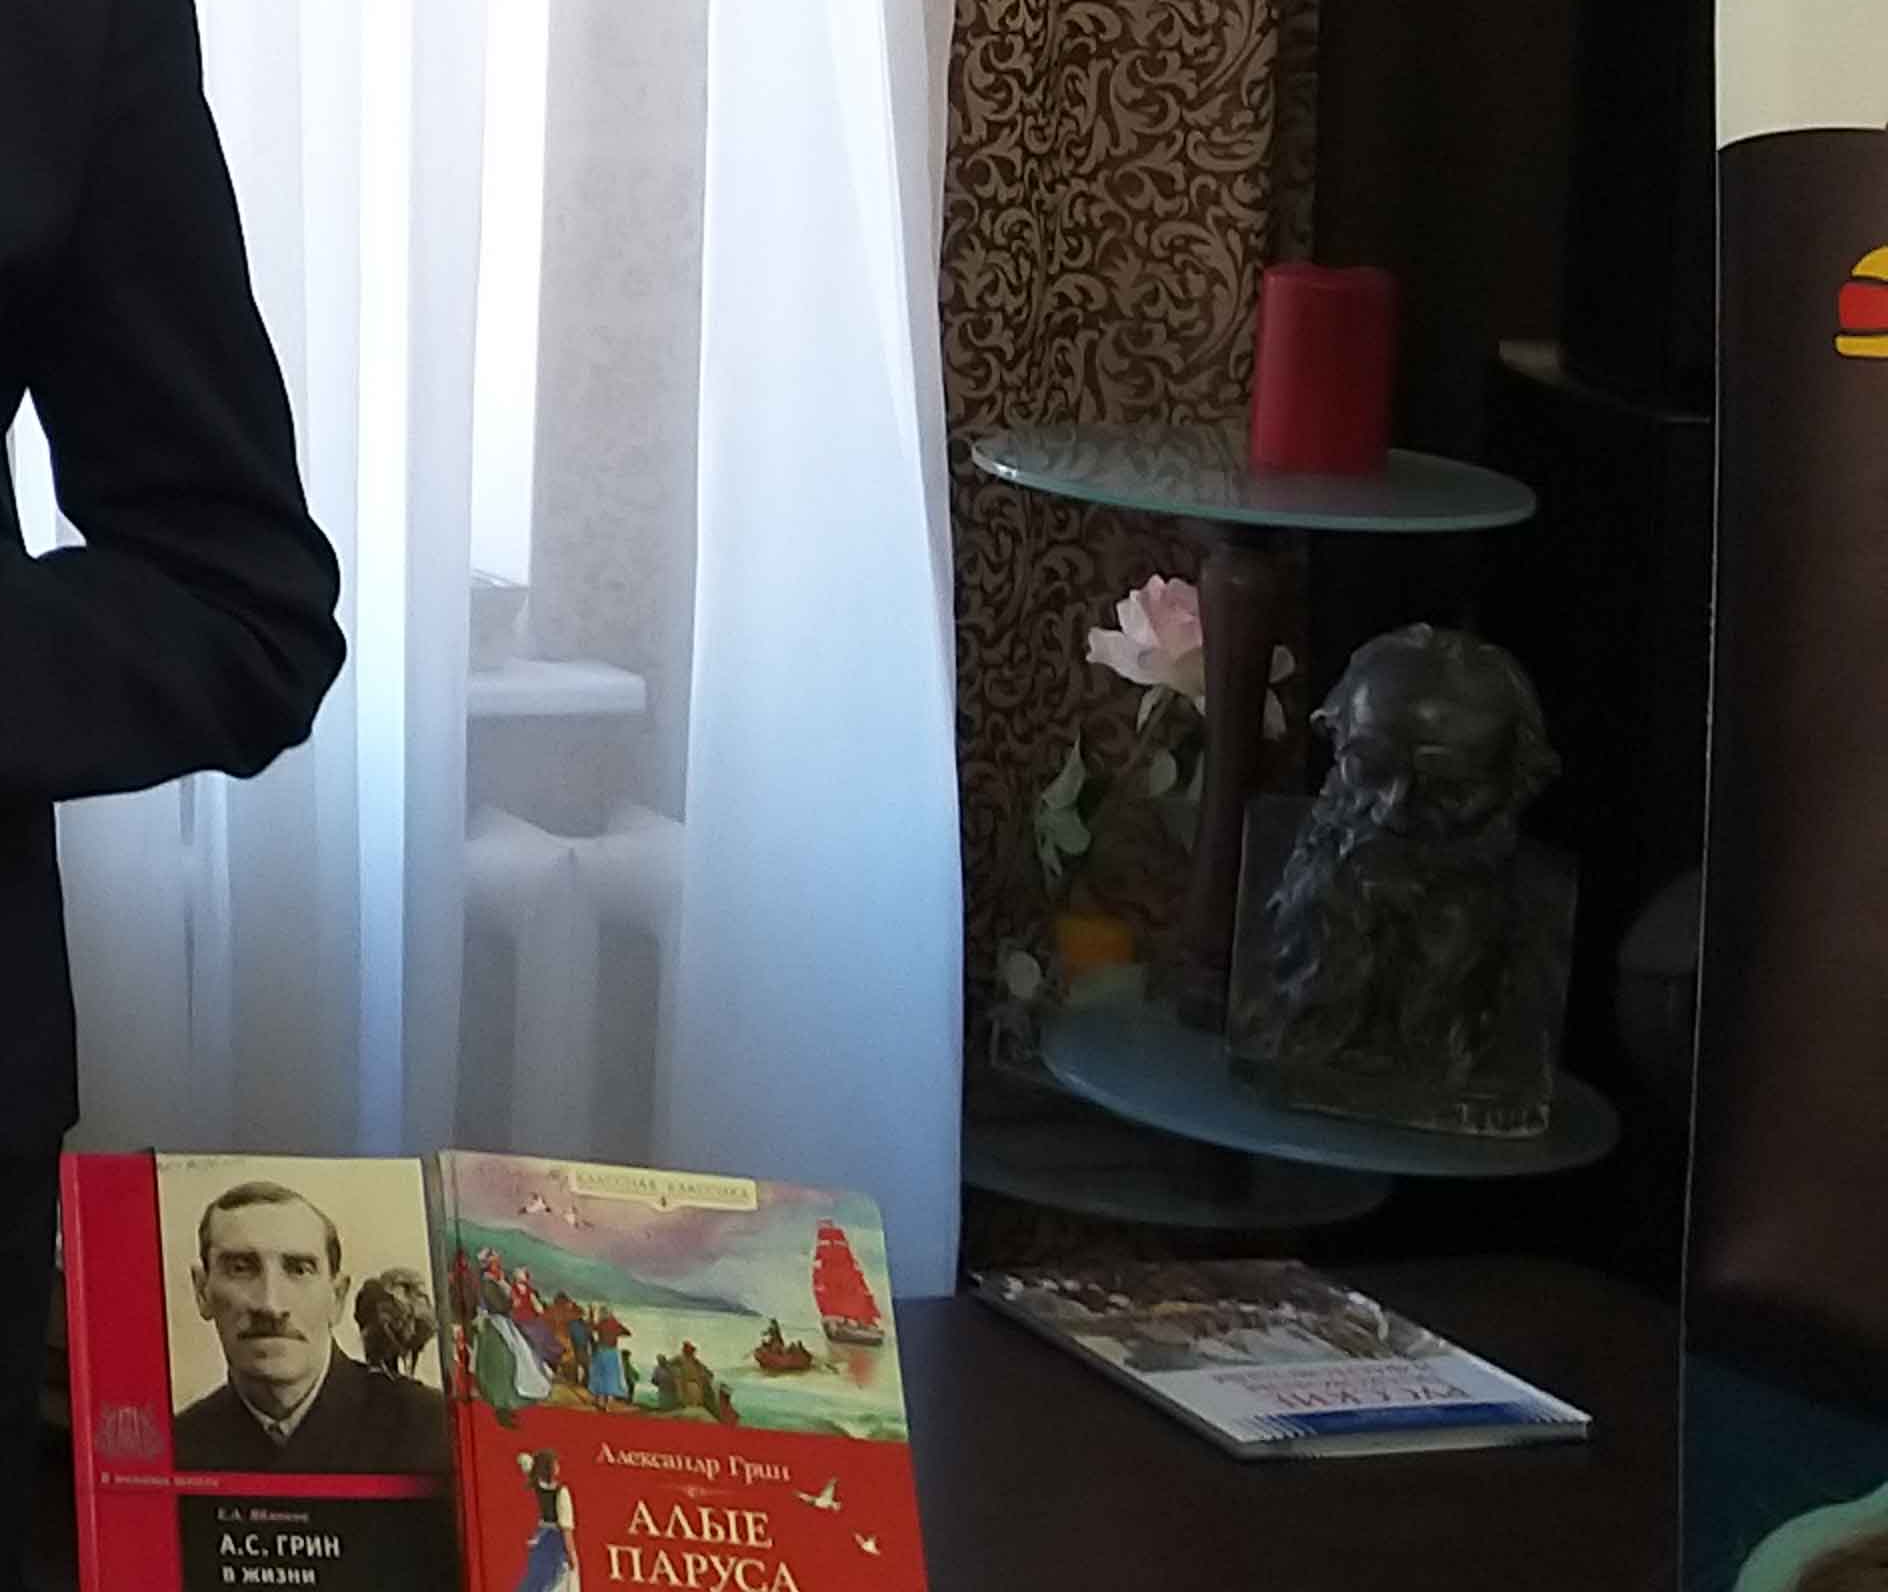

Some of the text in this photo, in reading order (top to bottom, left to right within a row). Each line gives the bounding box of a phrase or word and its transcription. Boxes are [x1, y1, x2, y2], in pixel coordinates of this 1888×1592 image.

[595, 1441, 791, 1485] Александр Грин
[219, 1533, 342, 1559] А.С. ГРИН
[627, 1499, 774, 1550] АЛЫЕ
[242, 1566, 317, 1586] жизни
[606, 1543, 803, 1592] ПАРУСА
